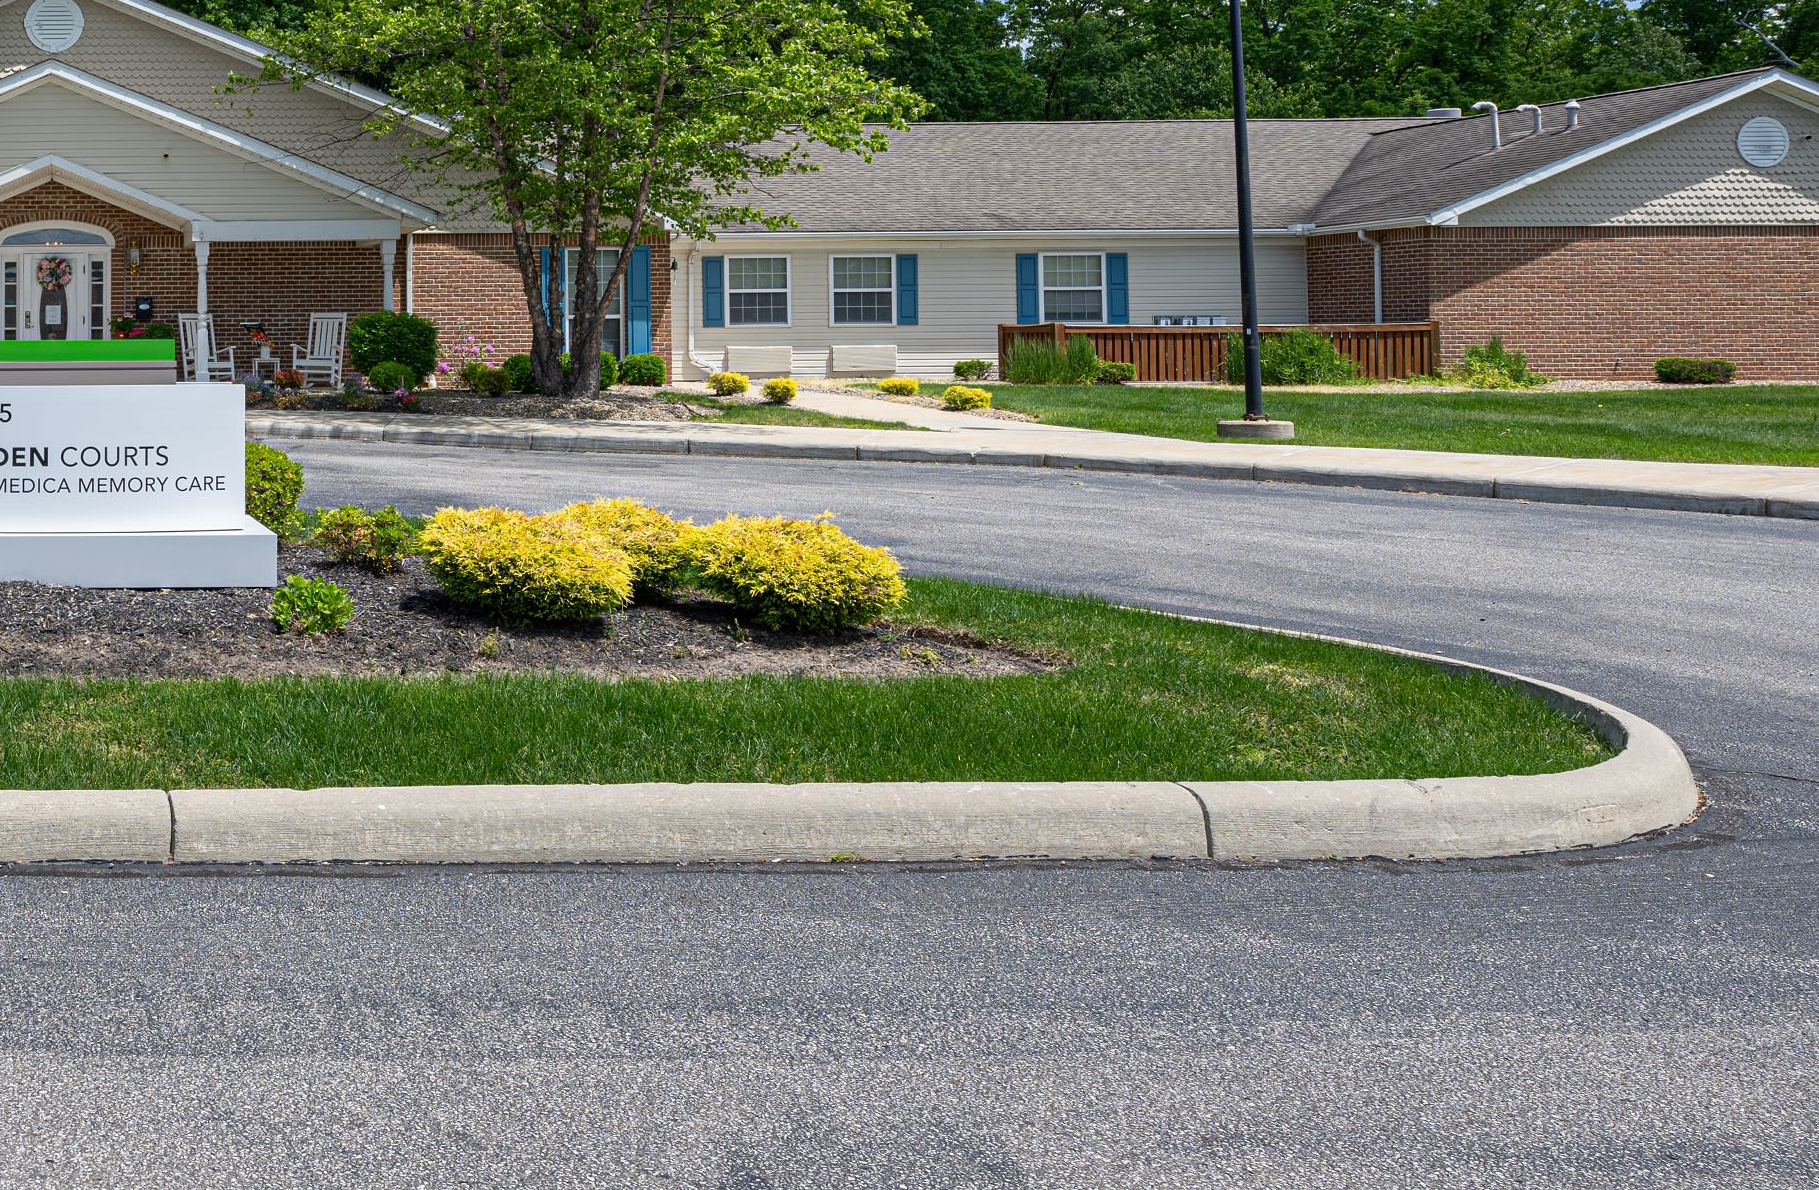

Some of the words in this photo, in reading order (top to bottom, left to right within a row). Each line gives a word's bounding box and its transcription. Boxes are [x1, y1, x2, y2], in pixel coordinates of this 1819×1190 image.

[60, 445, 169, 467] COURTS
[78, 476, 169, 493] MEMORY
[175, 475, 226, 491] CARE
